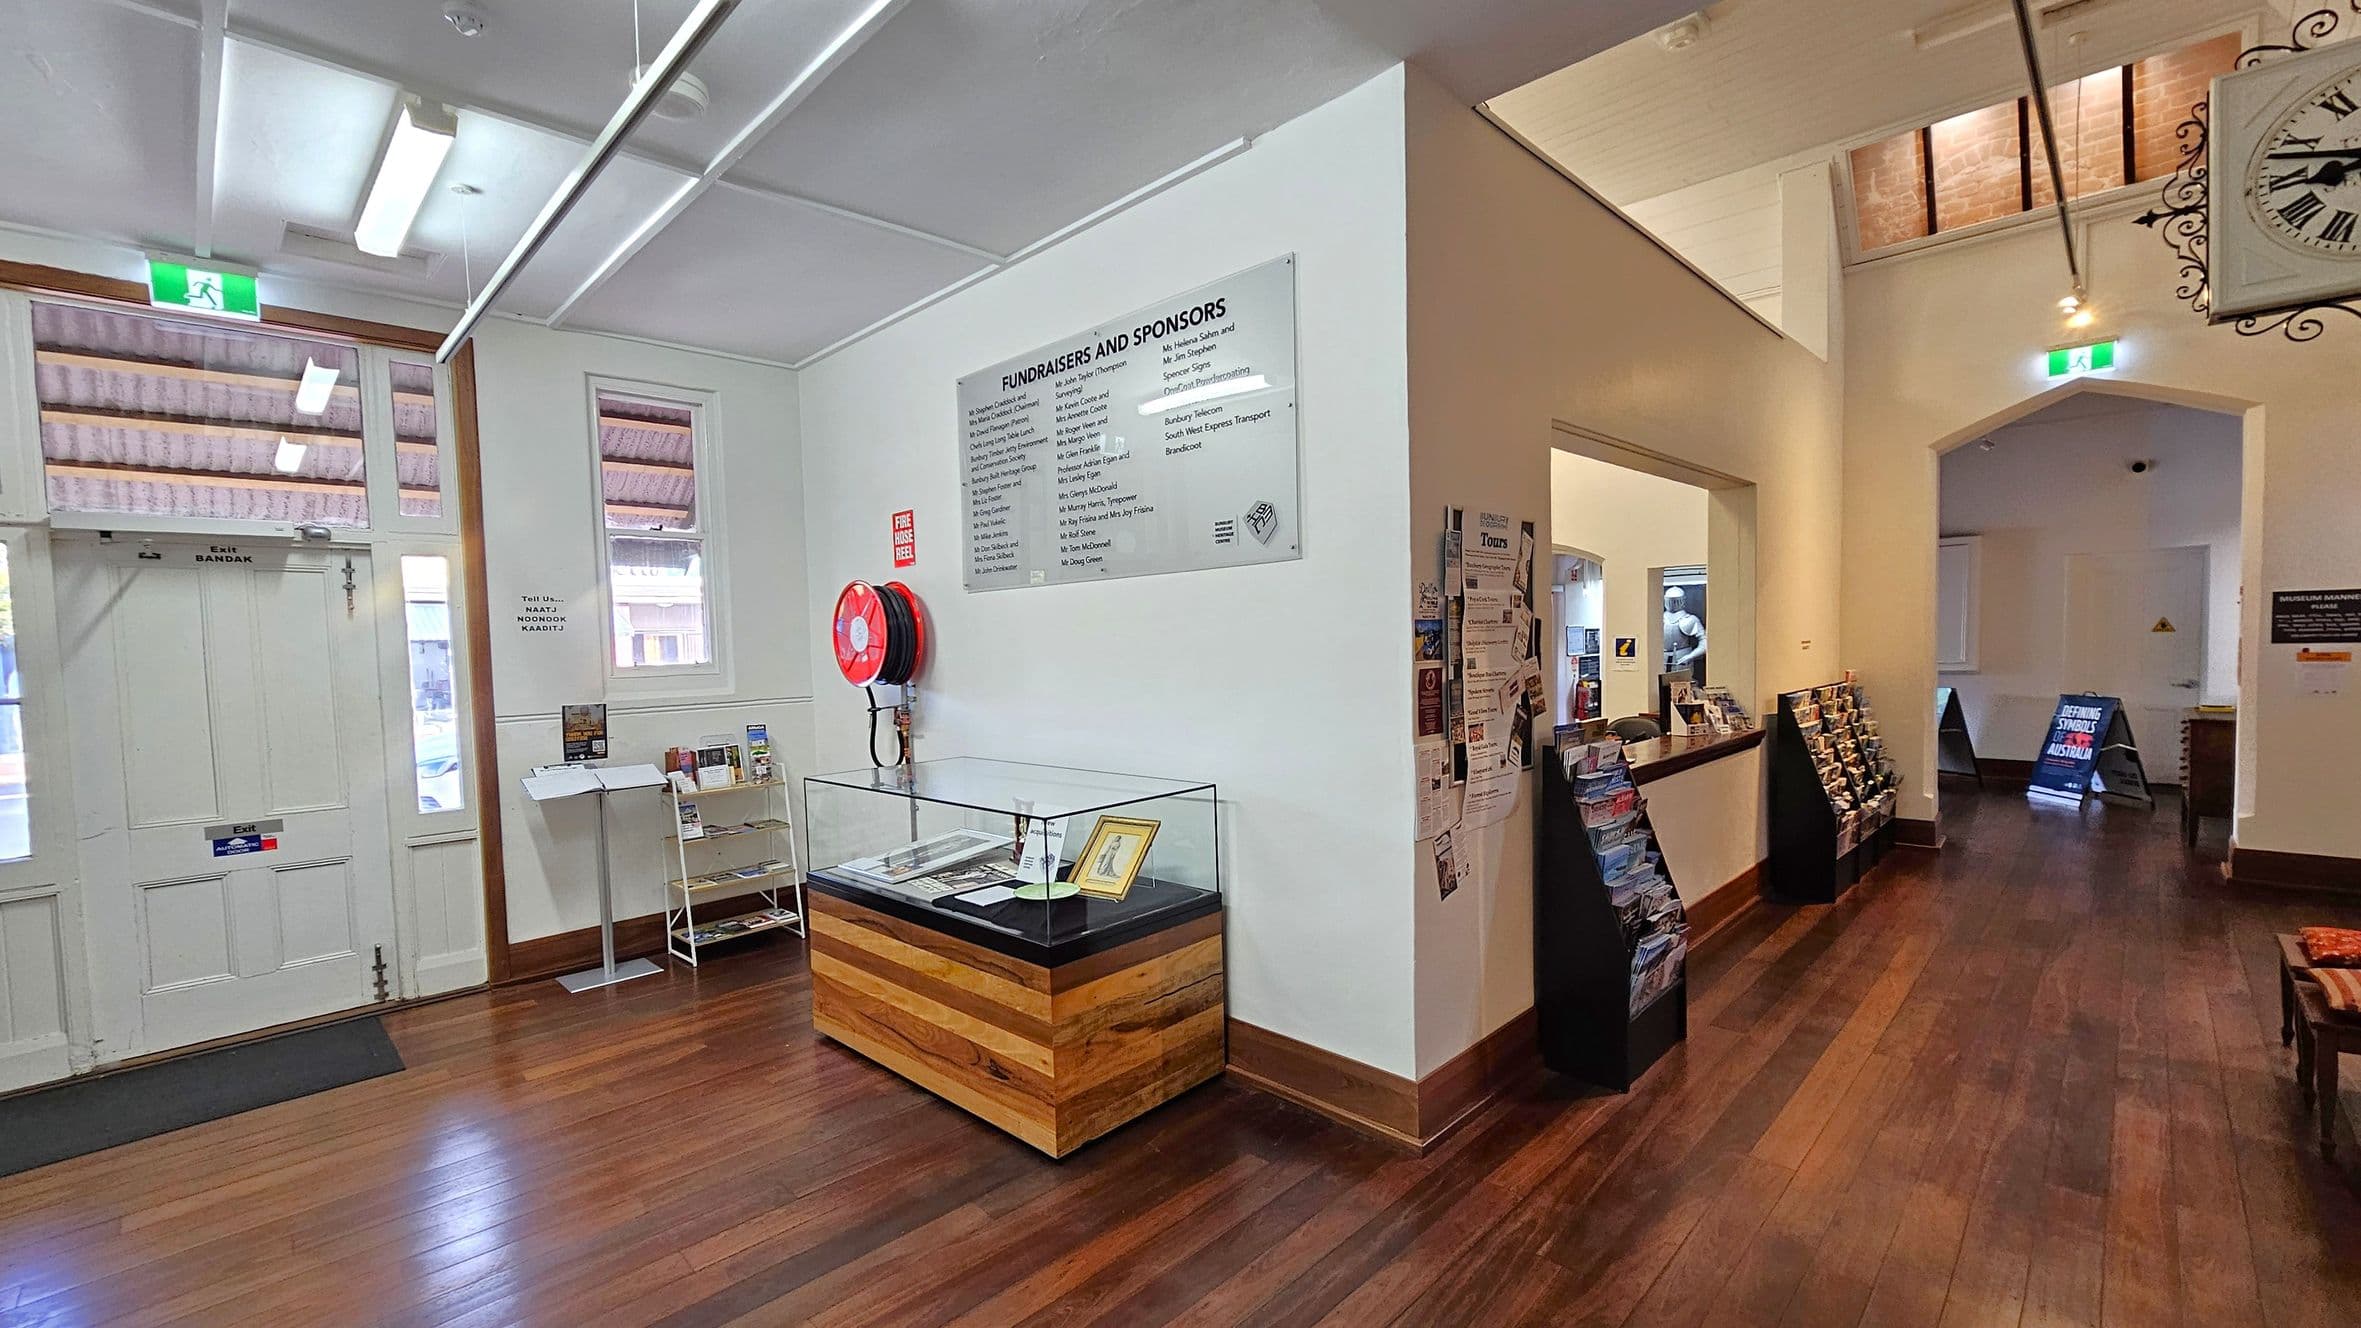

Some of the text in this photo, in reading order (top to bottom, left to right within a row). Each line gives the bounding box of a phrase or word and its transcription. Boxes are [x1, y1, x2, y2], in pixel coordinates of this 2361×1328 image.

[1163, 322, 1234, 352] Ms Helena Sahm and
[1002, 298, 1226, 391] FUNDRAISERS AND SPONSORS
[1163, 344, 1216, 364] Mr Jim Stephen
[1064, 377, 1077, 386] John
[1095, 361, 1127, 376] (Thompson
[1163, 362, 1211, 382] Spencer Signs
[976, 405, 993, 414] Stephen
[1017, 392, 1026, 401] and
[1065, 402, 1079, 410] Kevin
[1079, 396, 1097, 406] Coote
[1099, 390, 1109, 400] and
[1067, 410, 1088, 420] Annette
[1090, 404, 1107, 414] Coote
[1165, 414, 1192, 425] Bunbury
[1194, 407, 1223, 418] Telecom
[977, 428, 989, 436] David
[1065, 426, 1081, 434] Roger
[1097, 416, 1108, 425] and
[1165, 410, 1270, 440] South West Express Transport
[1007, 432, 1019, 440] Table
[1020, 426, 1034, 436] Lunch
[1068, 436, 1085, 444] Margo
[1018, 437, 1048, 450] Environment
[1166, 442, 1202, 455] Brandicoot
[1066, 450, 1078, 458] Glen
[971, 464, 979, 472] and
[1021, 464, 1036, 472] Group
[1058, 450, 1130, 474] Professor Adrian Egan and
[1069, 473, 1085, 482] Lesley
[1087, 471, 1100, 480] Egan
[979, 487, 996, 495] Stephen
[1089, 482, 1117, 494] McDonald
[1107, 495, 1137, 506] Tyrepower
[895, 513, 912, 529] FIRE
[1068, 518, 1078, 526] Ray
[1079, 515, 1096, 524] Frisina
[1098, 512, 1108, 520] and
[1122, 509, 1132, 518] Joy
[1134, 505, 1153, 514] Frisina
[895, 529, 914, 545] HOSE
[1010, 540, 1018, 548] and
[1481, 532, 1508, 548] Tours
[1082, 540, 1111, 550] McDonnell
[196, 555, 253, 563] BANDAK
[896, 545, 914, 560] REEL
[1070, 558, 1084, 566] Doug
[2062, 706, 2102, 720] DEFINING
[2057, 718, 2098, 733] SYMBOLS
[2053, 731, 2065, 742] OF
[2048, 744, 2092, 760] AUSTRALIA
[233, 825, 256, 834] Exit
[216, 842, 259, 851] AUTOMATIC
